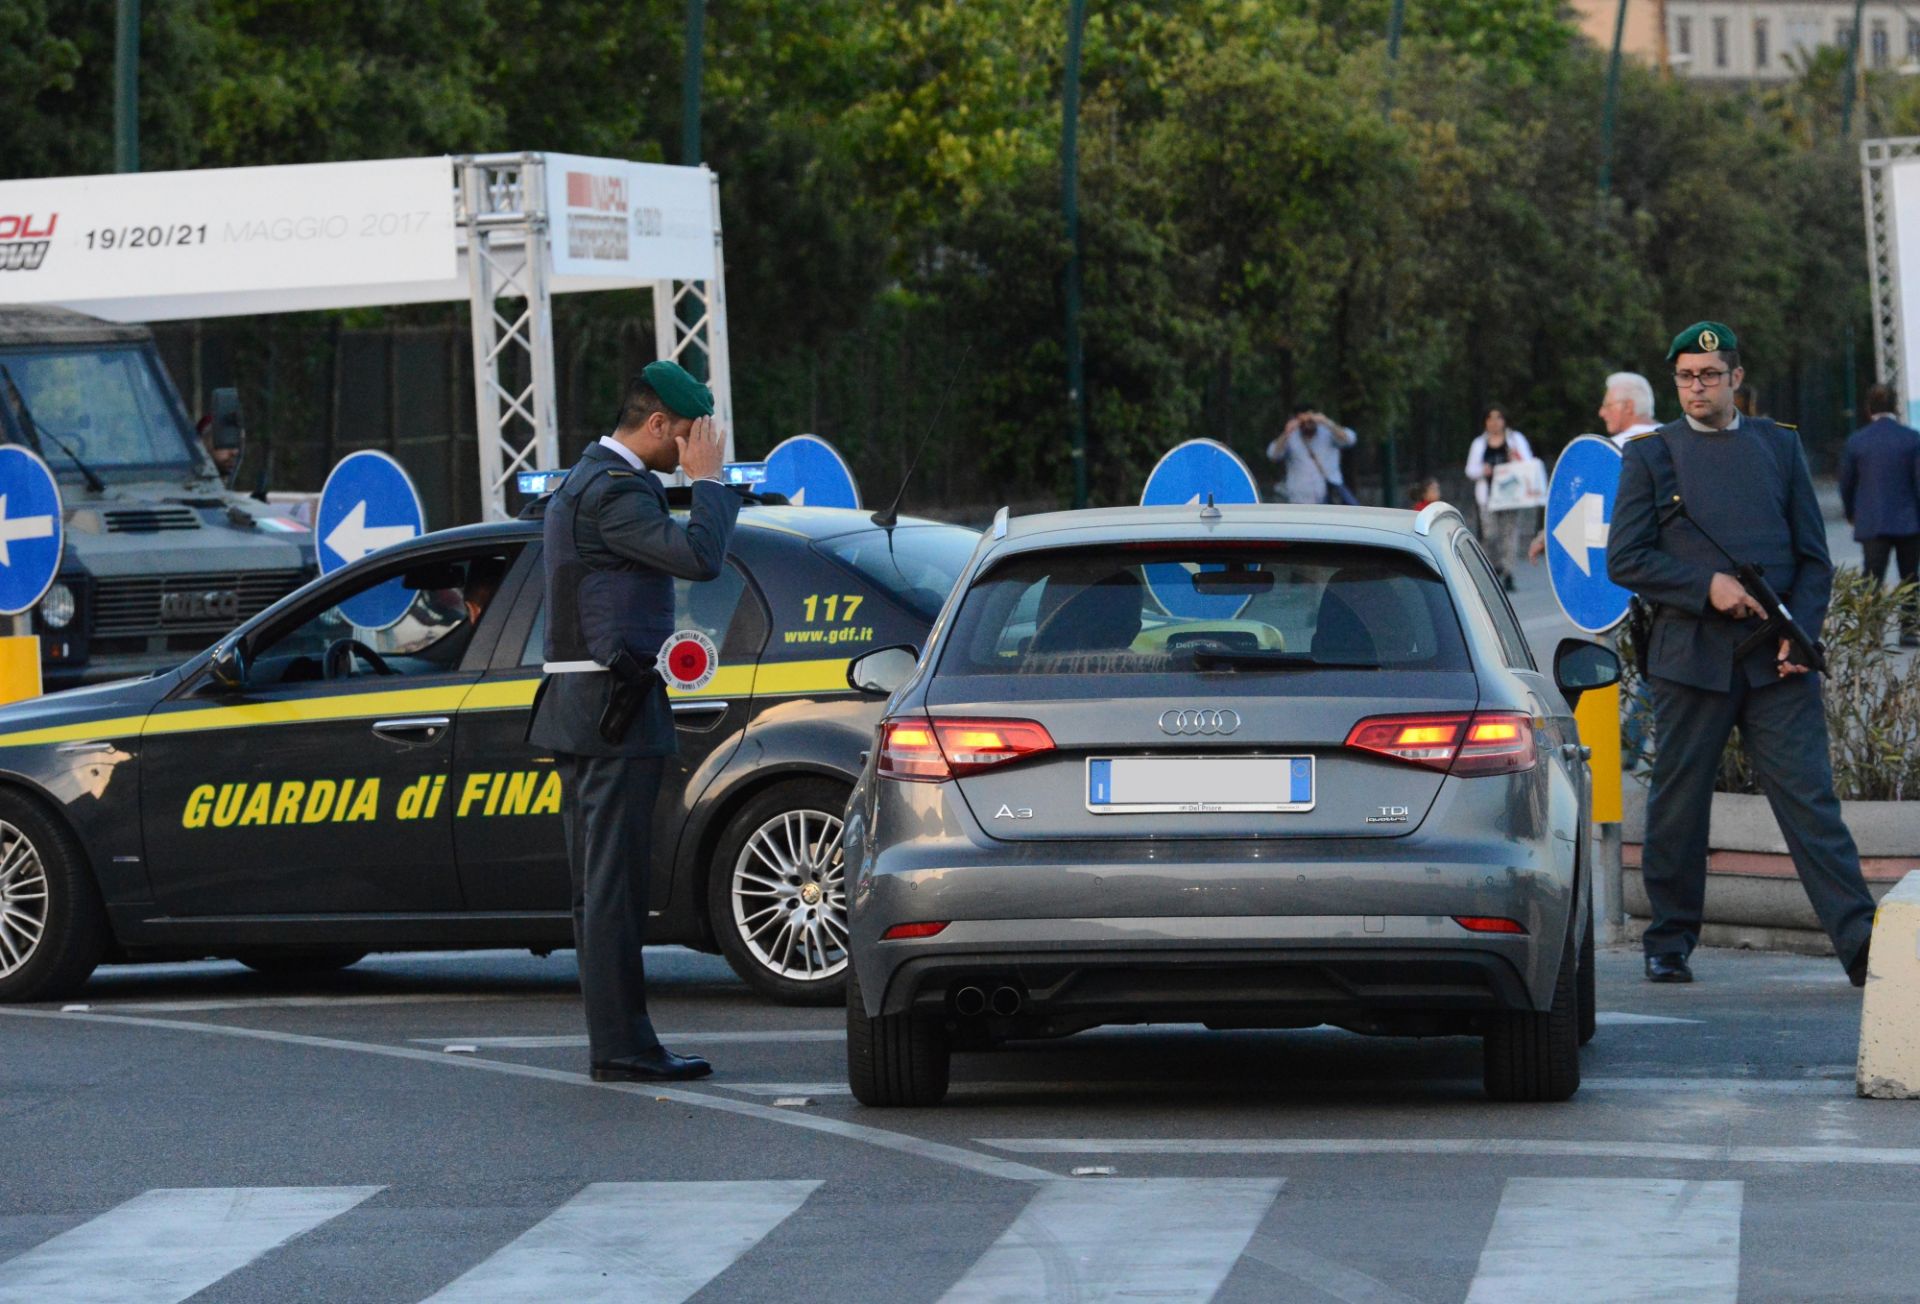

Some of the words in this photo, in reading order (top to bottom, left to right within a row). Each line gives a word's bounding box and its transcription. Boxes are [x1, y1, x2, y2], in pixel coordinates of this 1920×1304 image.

[85, 224, 208, 250] 19/20/21
[223, 214, 349, 243] MAGGIO
[360, 210, 430, 238] 2017
[803, 594, 864, 622] 117
[784, 627, 873, 644] www.gdf.it
[182, 778, 381, 828] GUARDIA
[396, 775, 447, 820] di
[994, 804, 1033, 819] A3
[1378, 806, 1408, 815] TDI
